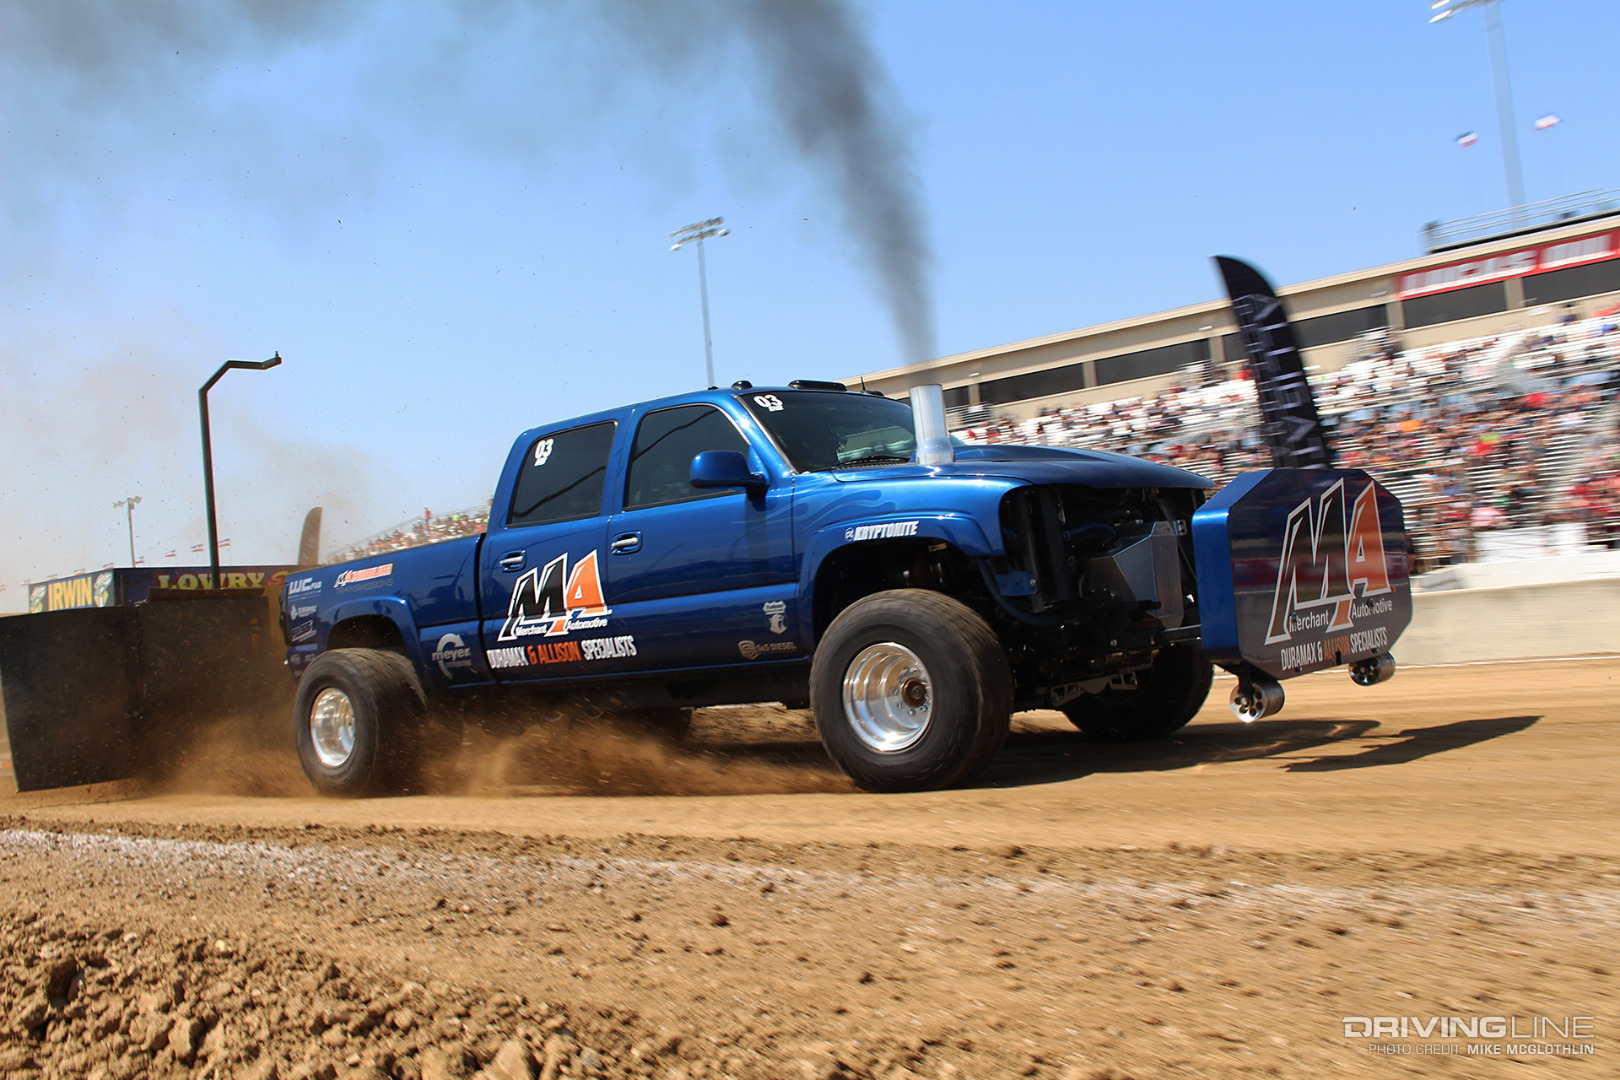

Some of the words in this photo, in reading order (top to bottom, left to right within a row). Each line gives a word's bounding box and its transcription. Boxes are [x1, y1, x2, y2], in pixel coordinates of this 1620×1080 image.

[534, 438, 554, 459] 03
[853, 520, 919, 541] KRYPTONITE
[48, 576, 92, 611] IRWIN
[486, 646, 529, 669] DURAMAX
[527, 645, 538, 664] &
[537, 641, 582, 664] ALLISON
[581, 635, 638, 660] SPECIALISTS
[1281, 641, 1317, 671] DURAMAX
[1317, 641, 1323, 661] &
[1350, 626, 1388, 654] SPECIALISTS
